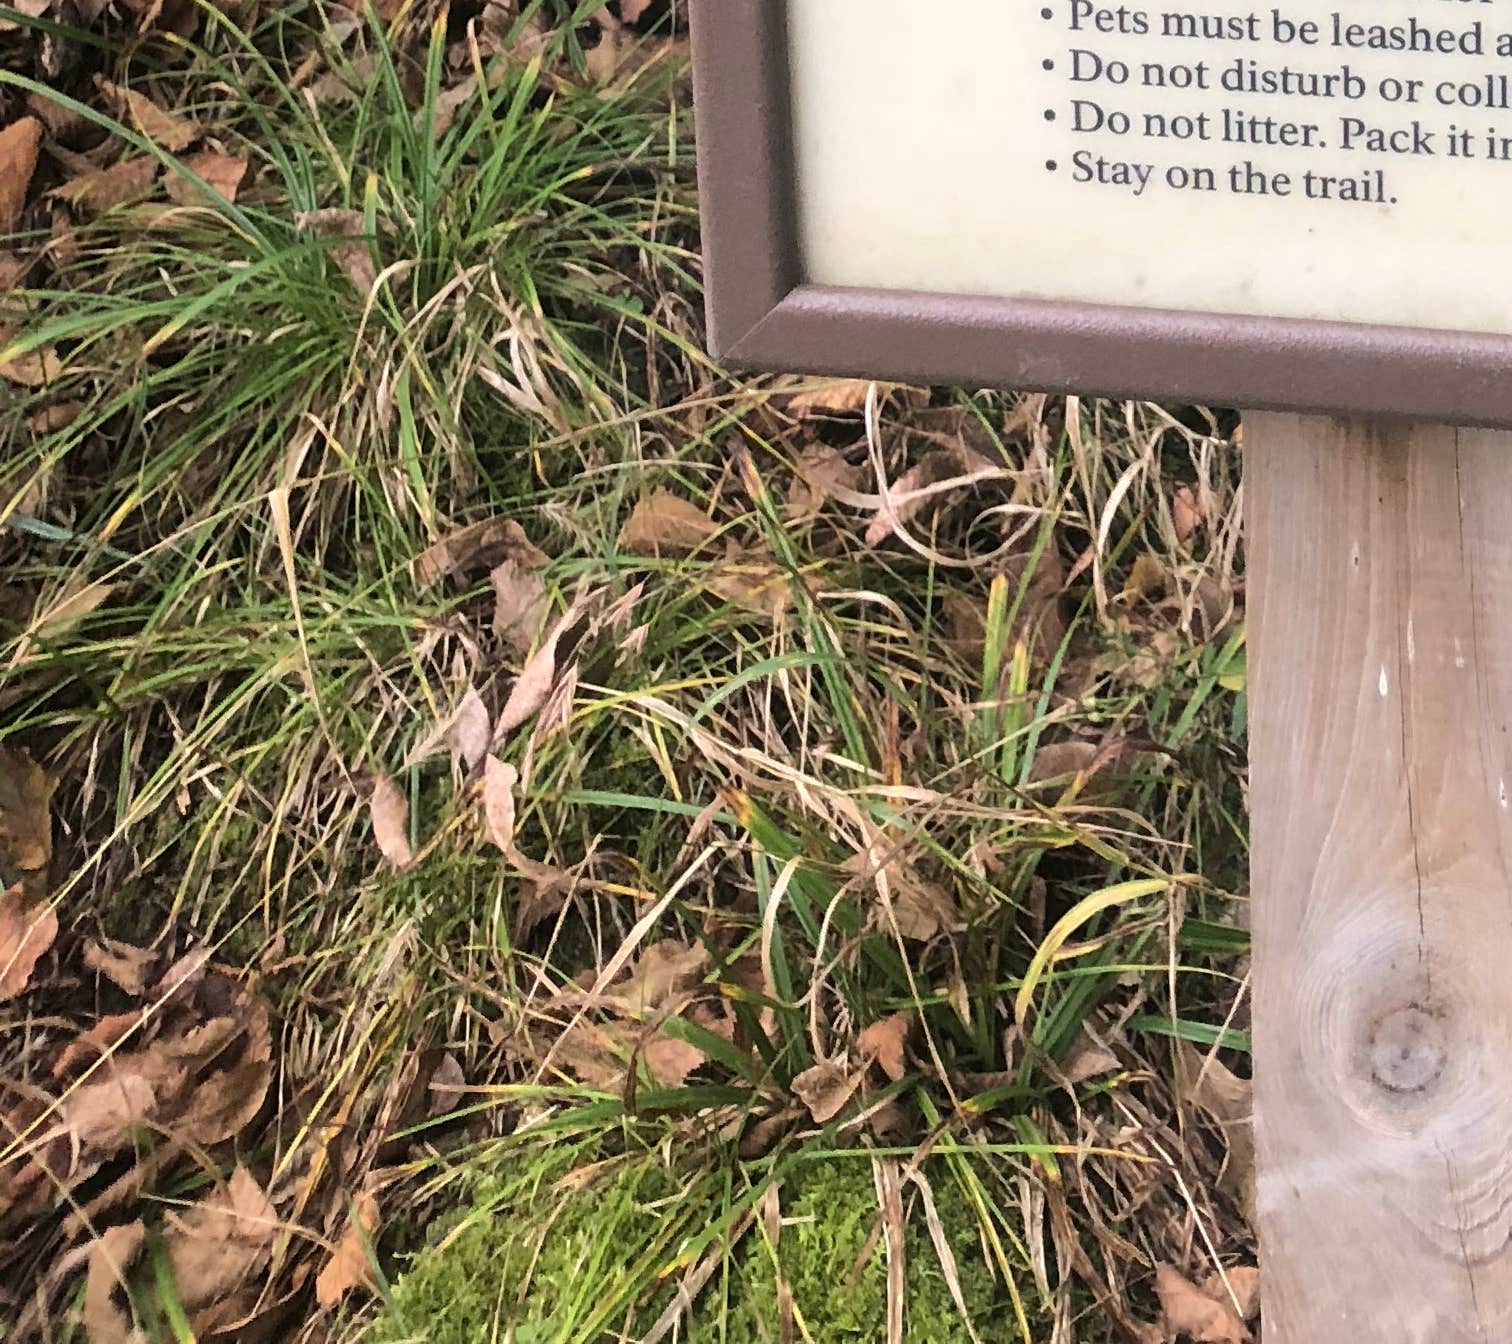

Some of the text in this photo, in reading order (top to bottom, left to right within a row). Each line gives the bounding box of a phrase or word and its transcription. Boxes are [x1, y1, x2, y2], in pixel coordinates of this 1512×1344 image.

[1068, 0, 1148, 34] Pets
[1161, 13, 1260, 41] must
[1271, 9, 1318, 44] be
[1331, 13, 1484, 55] leashed
[1069, 49, 1129, 84] Do
[1142, 62, 1209, 89] not
[1221, 59, 1366, 99] disturb
[1379, 78, 1423, 102] or
[1071, 100, 1130, 134] Do
[1143, 112, 1211, 140] not
[1222, 109, 1326, 148] litter.
[1340, 118, 1435, 154] Pack
[1448, 125, 1474, 158] it
[1073, 151, 1397, 204] Stay on the trail.
